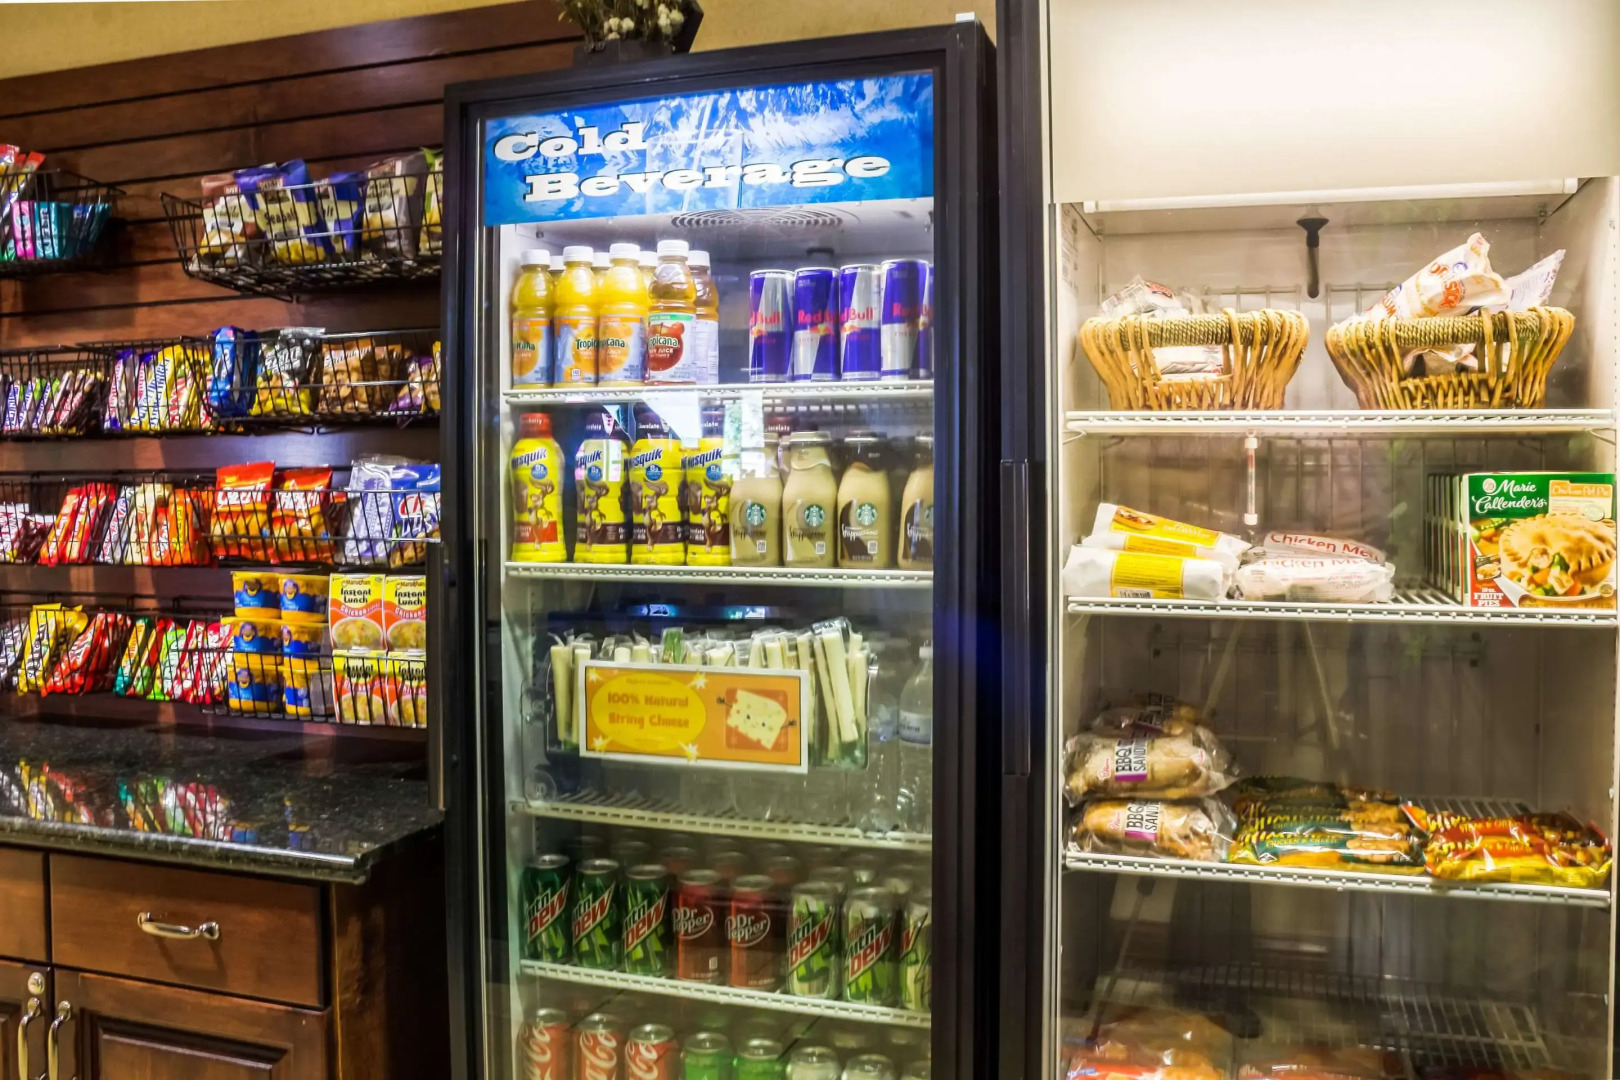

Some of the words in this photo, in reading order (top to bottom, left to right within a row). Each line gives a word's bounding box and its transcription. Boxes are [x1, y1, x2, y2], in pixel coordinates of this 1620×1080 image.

[494, 121, 648, 161] Cold
[523, 155, 891, 202] Beverage
[848, 306, 875, 321] Bull
[1494, 479, 1537, 498] Marie
[1472, 496, 1547, 514] Callender's
[1270, 534, 1337, 553] Chicken
[340, 588, 372, 596] Instant
[607, 692, 640, 705] 100%
[644, 694, 689, 708] Natural
[608, 712, 645, 730] String
[649, 713, 690, 728] Cheese
[1115, 747, 1133, 773] BBQ
[679, 906, 698, 920] Dr
[736, 913, 755, 926] Dr
[727, 915, 768, 943] Pepper
